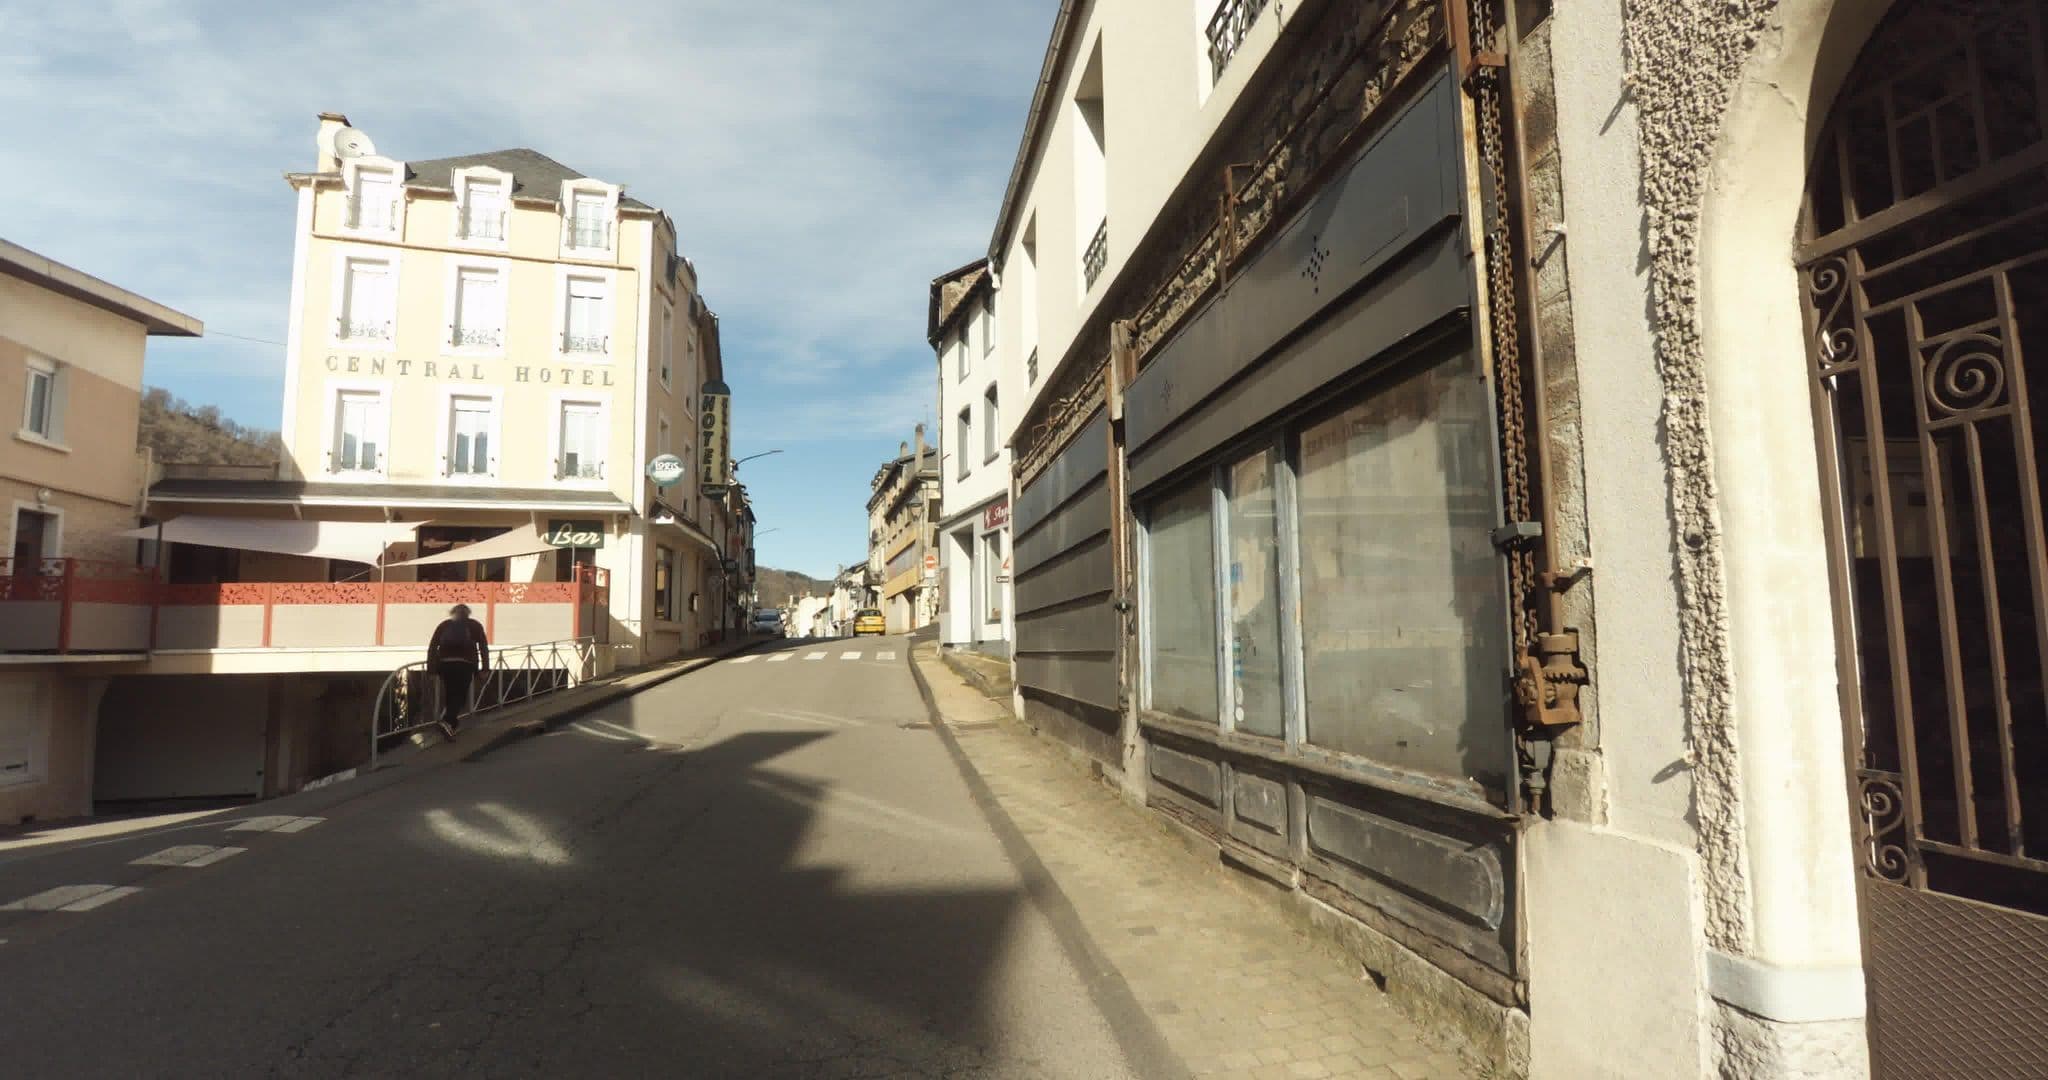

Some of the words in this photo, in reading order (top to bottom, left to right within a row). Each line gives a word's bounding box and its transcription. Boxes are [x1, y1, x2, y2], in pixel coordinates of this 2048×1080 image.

[325, 355, 484, 380] CENTRAL
[515, 365, 614, 386] HOTEL
[702, 395, 715, 482] HOTEL
[551, 523, 600, 545] Bar
